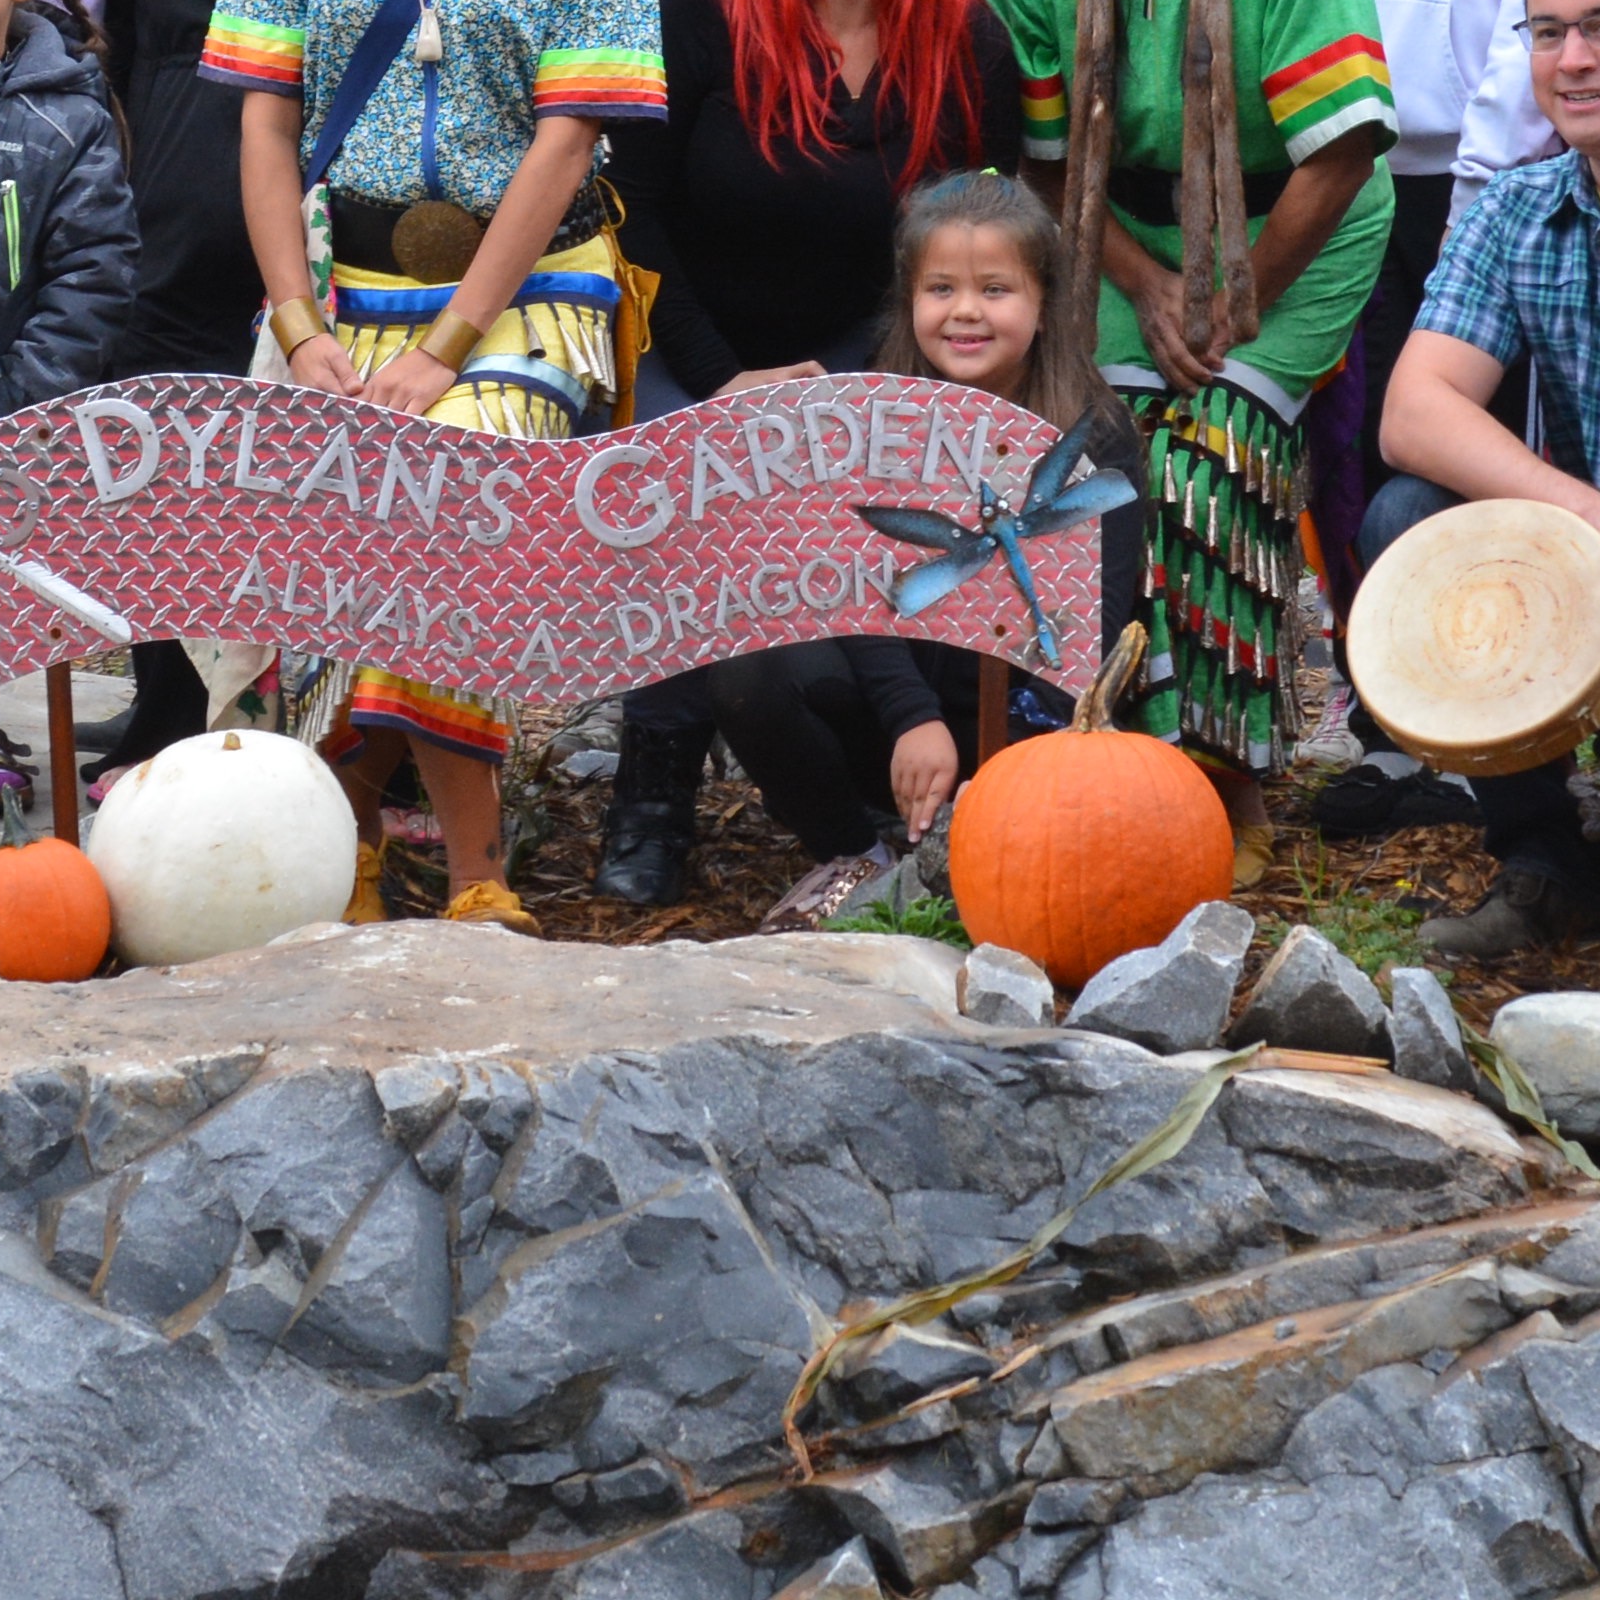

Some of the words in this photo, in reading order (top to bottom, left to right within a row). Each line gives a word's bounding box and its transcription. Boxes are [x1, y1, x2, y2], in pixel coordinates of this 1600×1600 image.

[73, 398, 527, 547] DYLAN'S
[574, 399, 989, 548] GARDEN
[228, 552, 479, 658] ALWAYS
[516, 619, 563, 675] A
[615, 552, 894, 654] DRAGON
